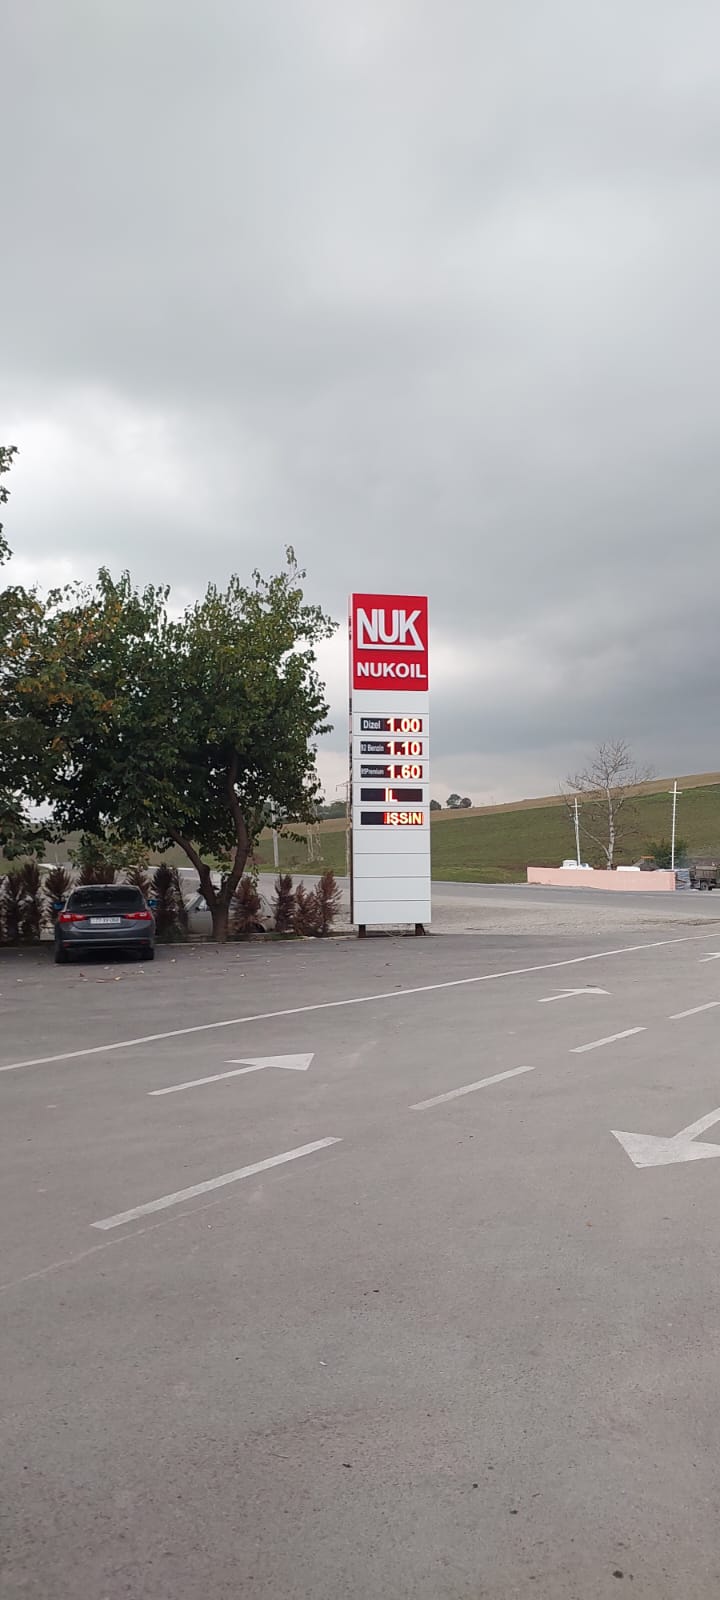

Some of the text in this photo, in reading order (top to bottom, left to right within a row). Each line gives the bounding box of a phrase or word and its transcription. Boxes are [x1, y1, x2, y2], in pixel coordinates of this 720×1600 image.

[356, 607, 425, 651] NUK
[356, 661, 427, 678] NUKOIL
[363, 718, 421, 732] Dizel 1.00
[386, 741, 421, 756] 1.10
[386, 764, 421, 779] 1.60
